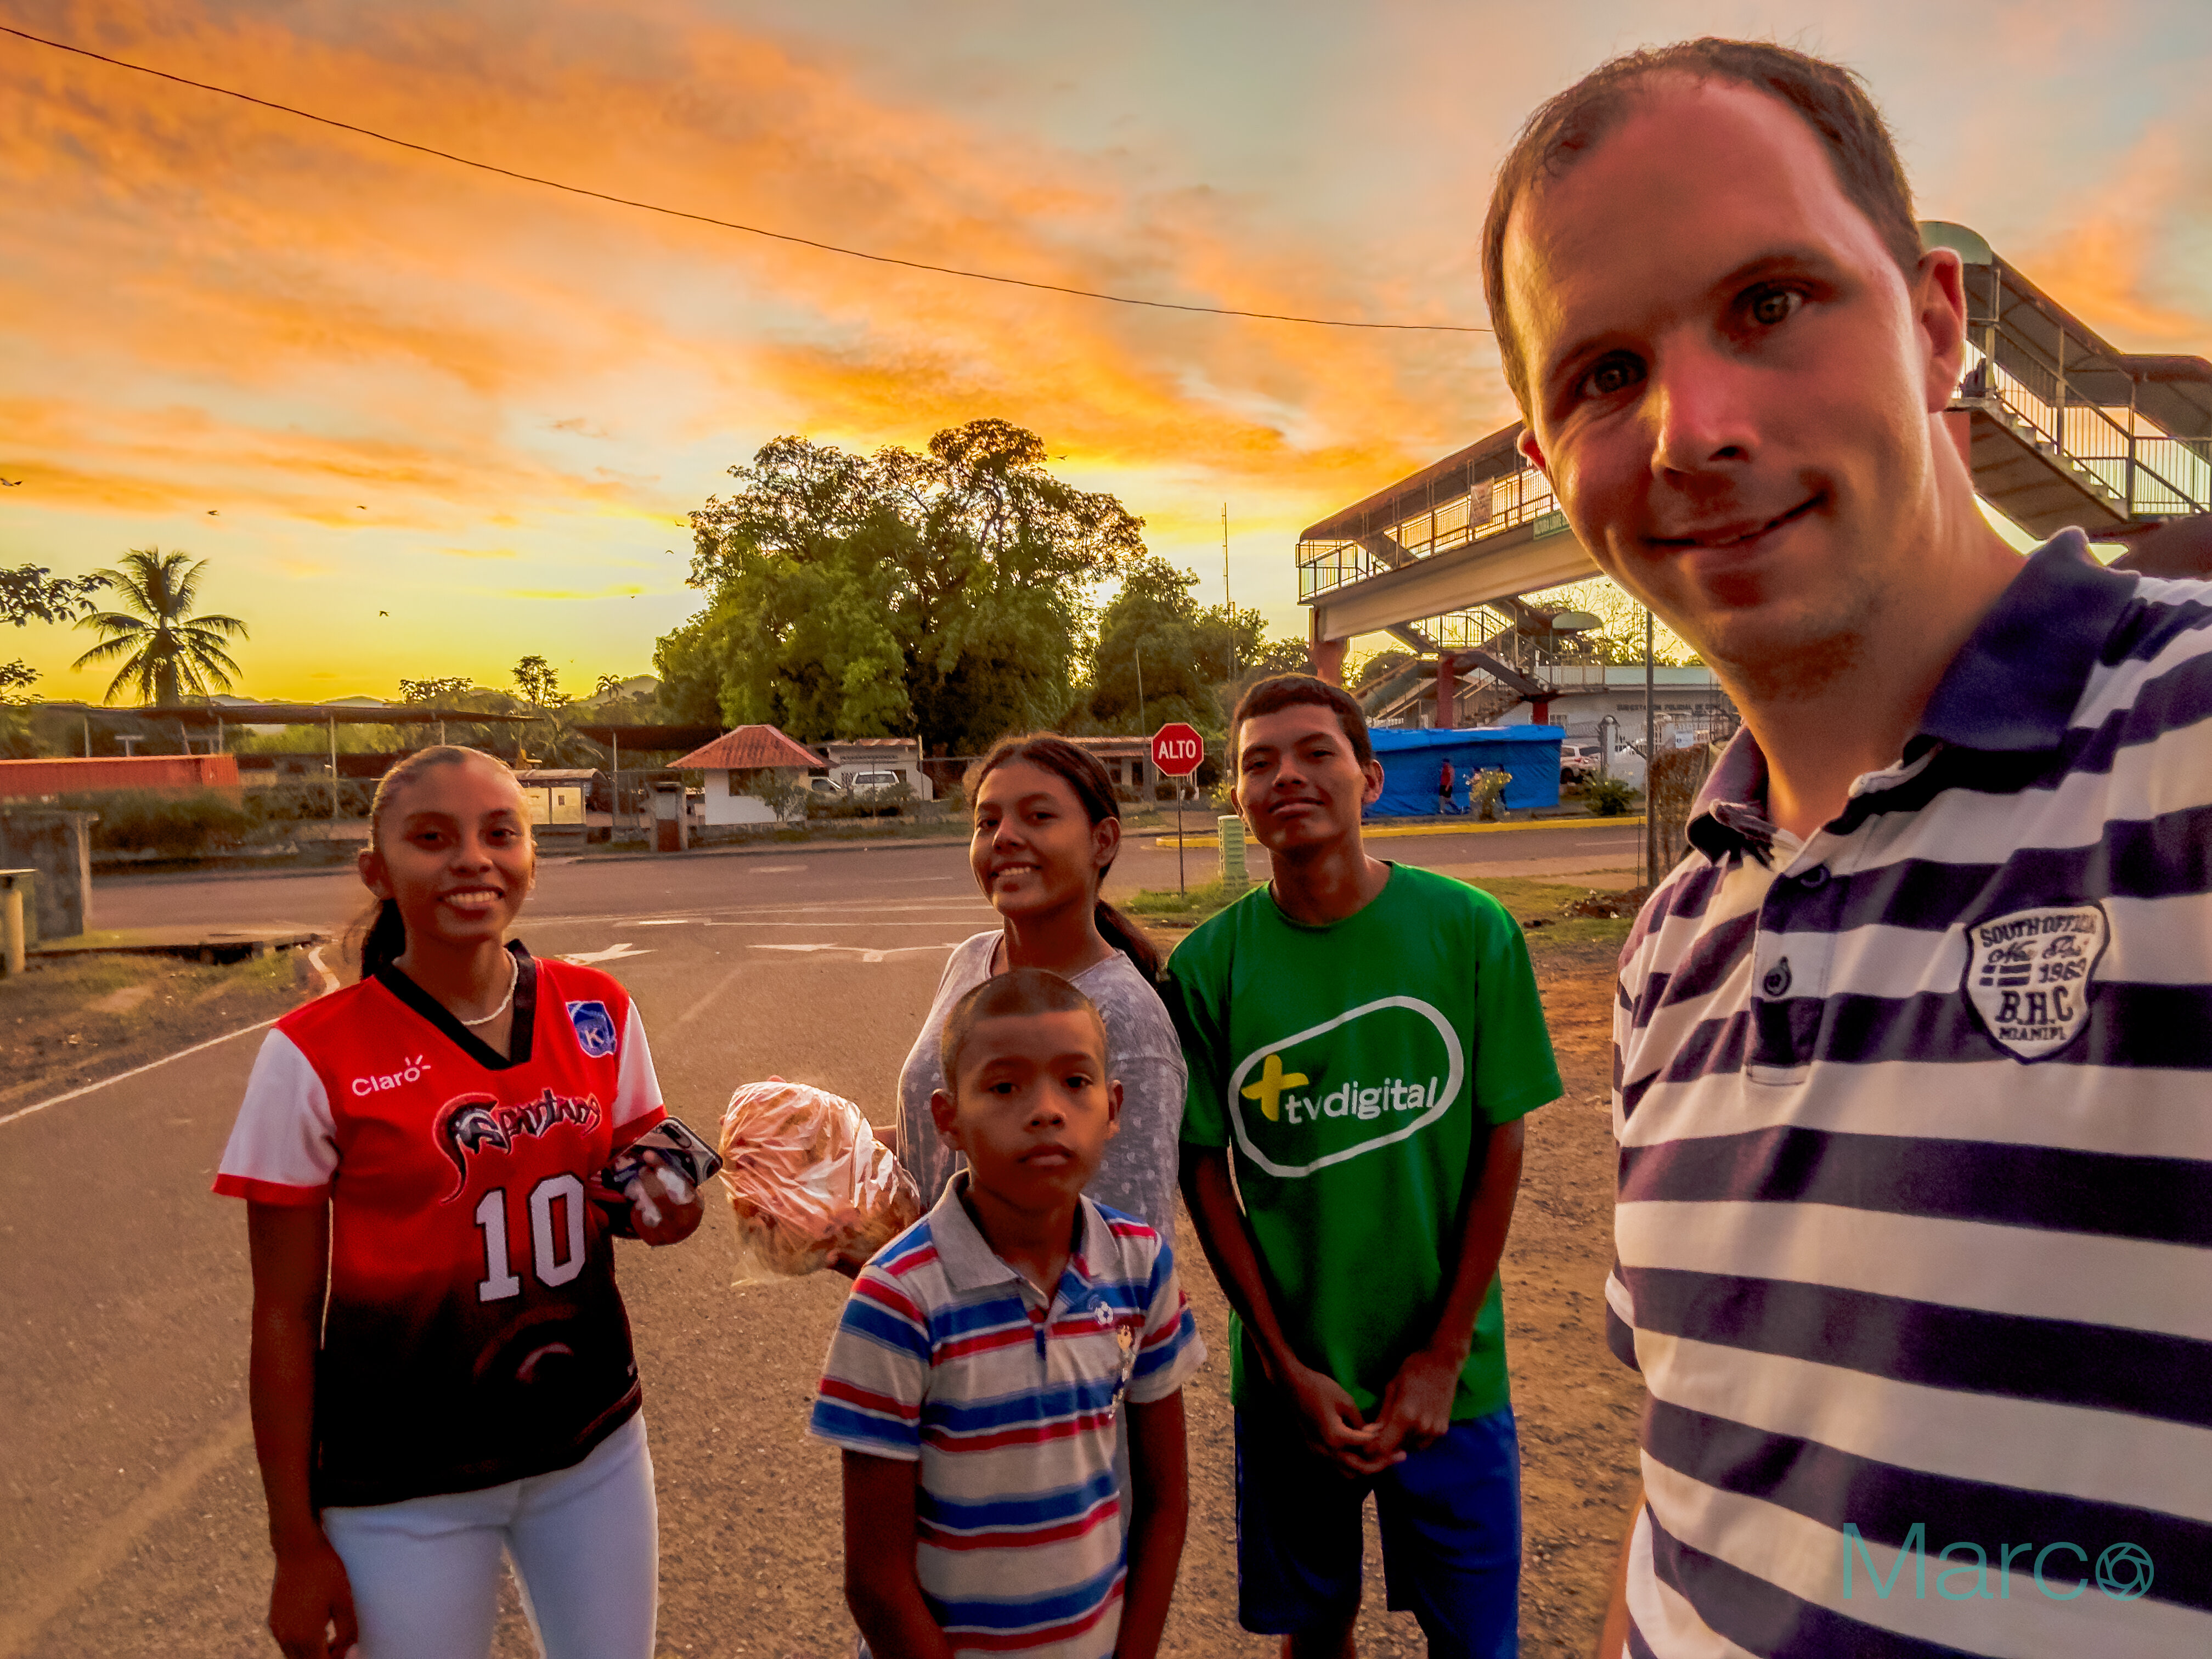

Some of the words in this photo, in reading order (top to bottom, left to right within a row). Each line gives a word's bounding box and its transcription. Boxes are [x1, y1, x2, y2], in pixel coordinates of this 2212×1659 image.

[1158, 740, 1197, 759] ALTO
[1980, 917, 2040, 947] SOUTH
[352, 1063, 421, 1096] Claro
[476, 1173, 586, 1302] 10
